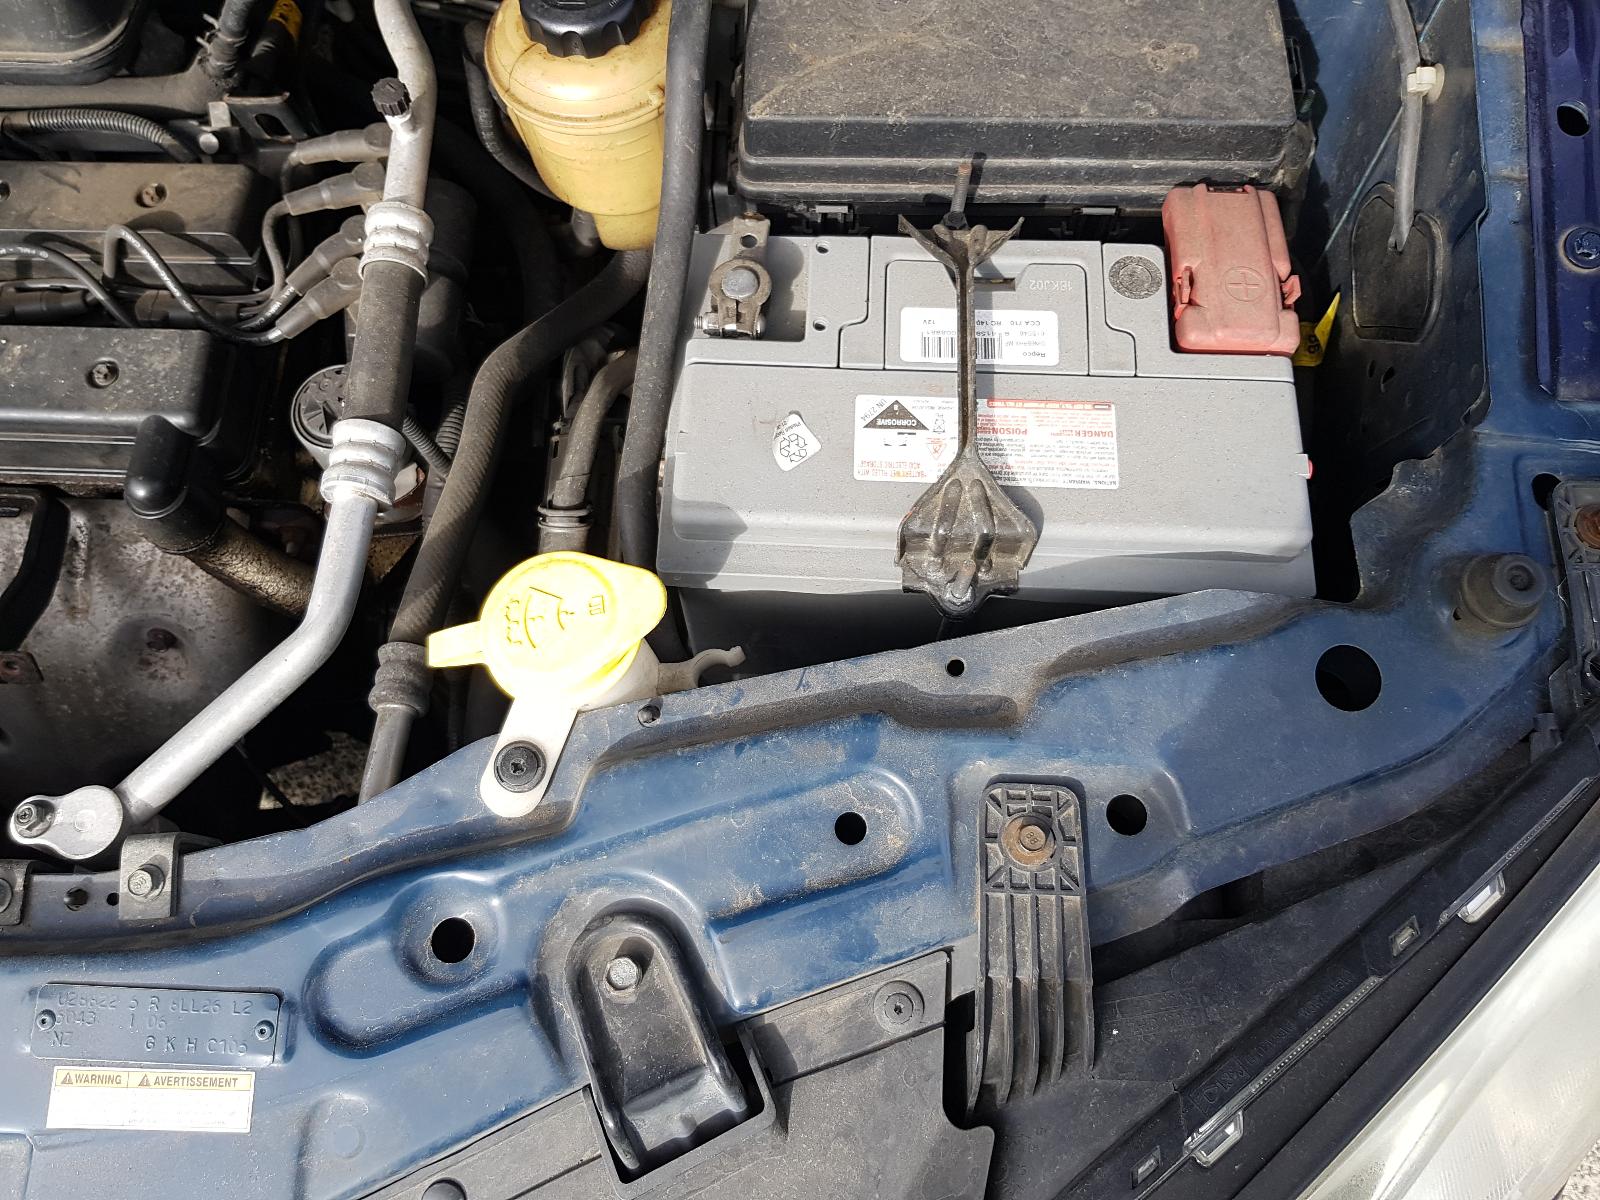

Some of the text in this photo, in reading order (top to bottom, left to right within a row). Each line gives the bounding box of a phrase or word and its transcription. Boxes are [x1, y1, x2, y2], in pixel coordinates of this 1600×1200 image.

[876, 418, 917, 426] CORROSIVE
[992, 427, 1028, 436] POISON
[1075, 430, 1114, 439] DANGER
[75, 1073, 239, 1088] WARNING AVERTISSEMENT
